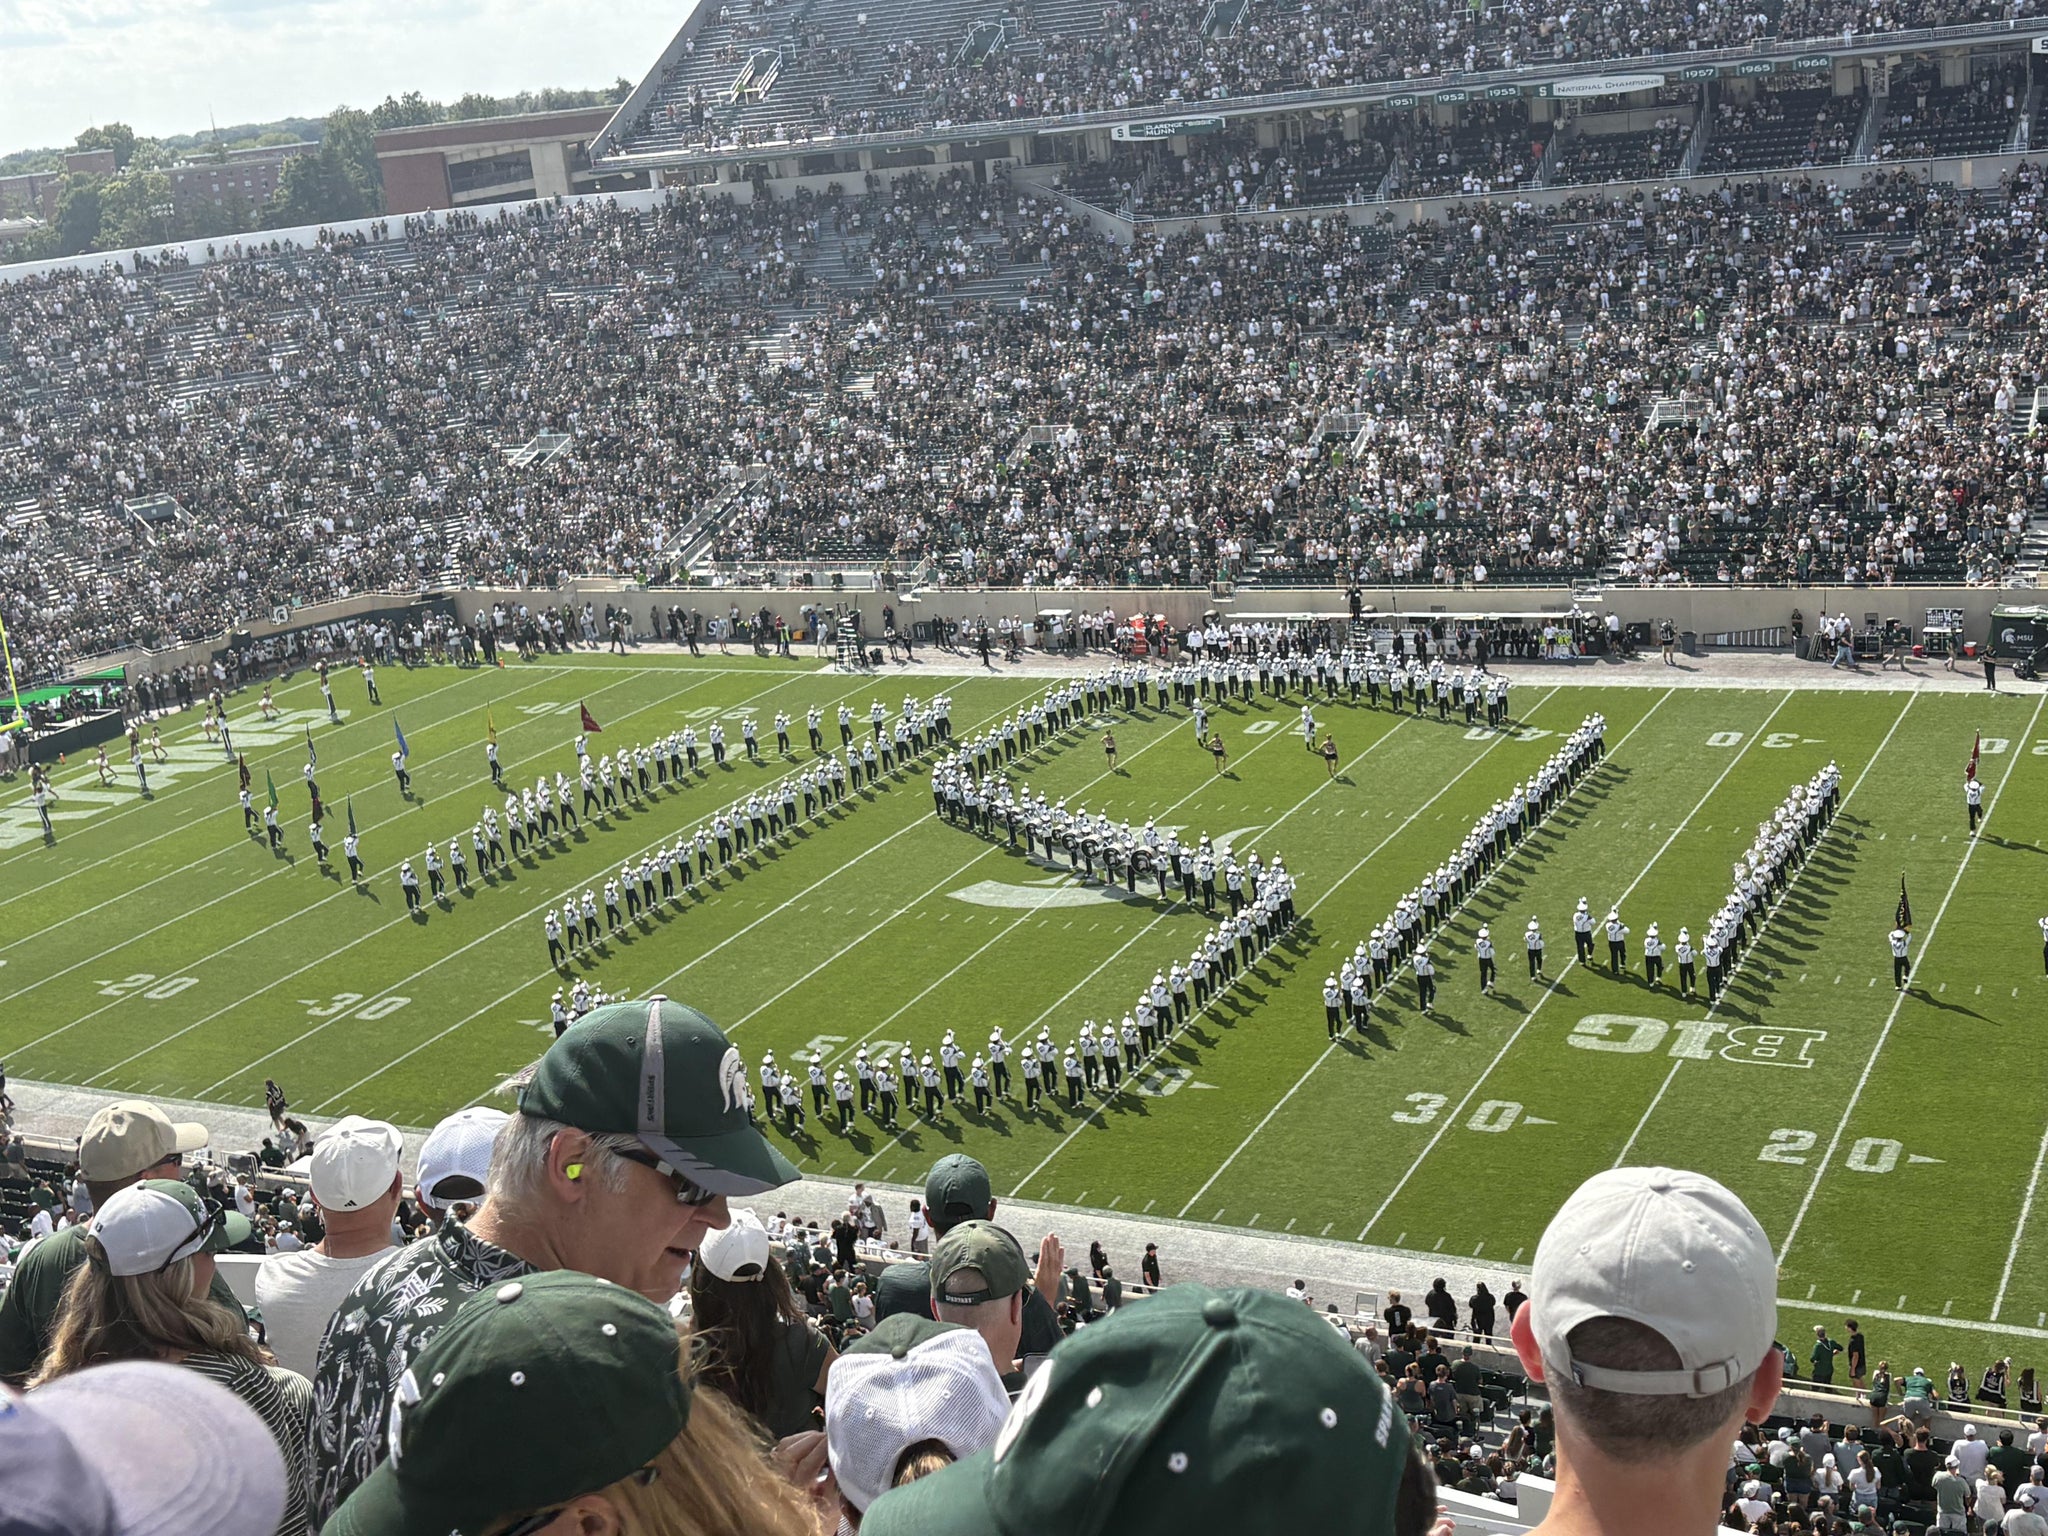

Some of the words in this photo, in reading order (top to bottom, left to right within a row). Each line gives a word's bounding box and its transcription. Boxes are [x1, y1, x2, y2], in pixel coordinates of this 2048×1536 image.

[1798, 58, 1828, 67] 1966
[1685, 69, 1714, 78] 1957
[1741, 64, 1771, 74] 1965
[1489, 88, 1516, 97] 1955
[1557, 83, 1603, 93] NATIONAL
[1390, 98, 1413, 107] 1951
[1438, 93, 1465, 102] 1952
[1145, 127, 1176, 136] MUNN
[685, 706, 761, 720] 20
[1705, 731, 1800, 748] 30
[98, 973, 200, 1000] 20
[307, 993, 412, 1021] 30
[1391, 1091, 1524, 1133] 30
[1757, 1128, 1904, 1174] 20
